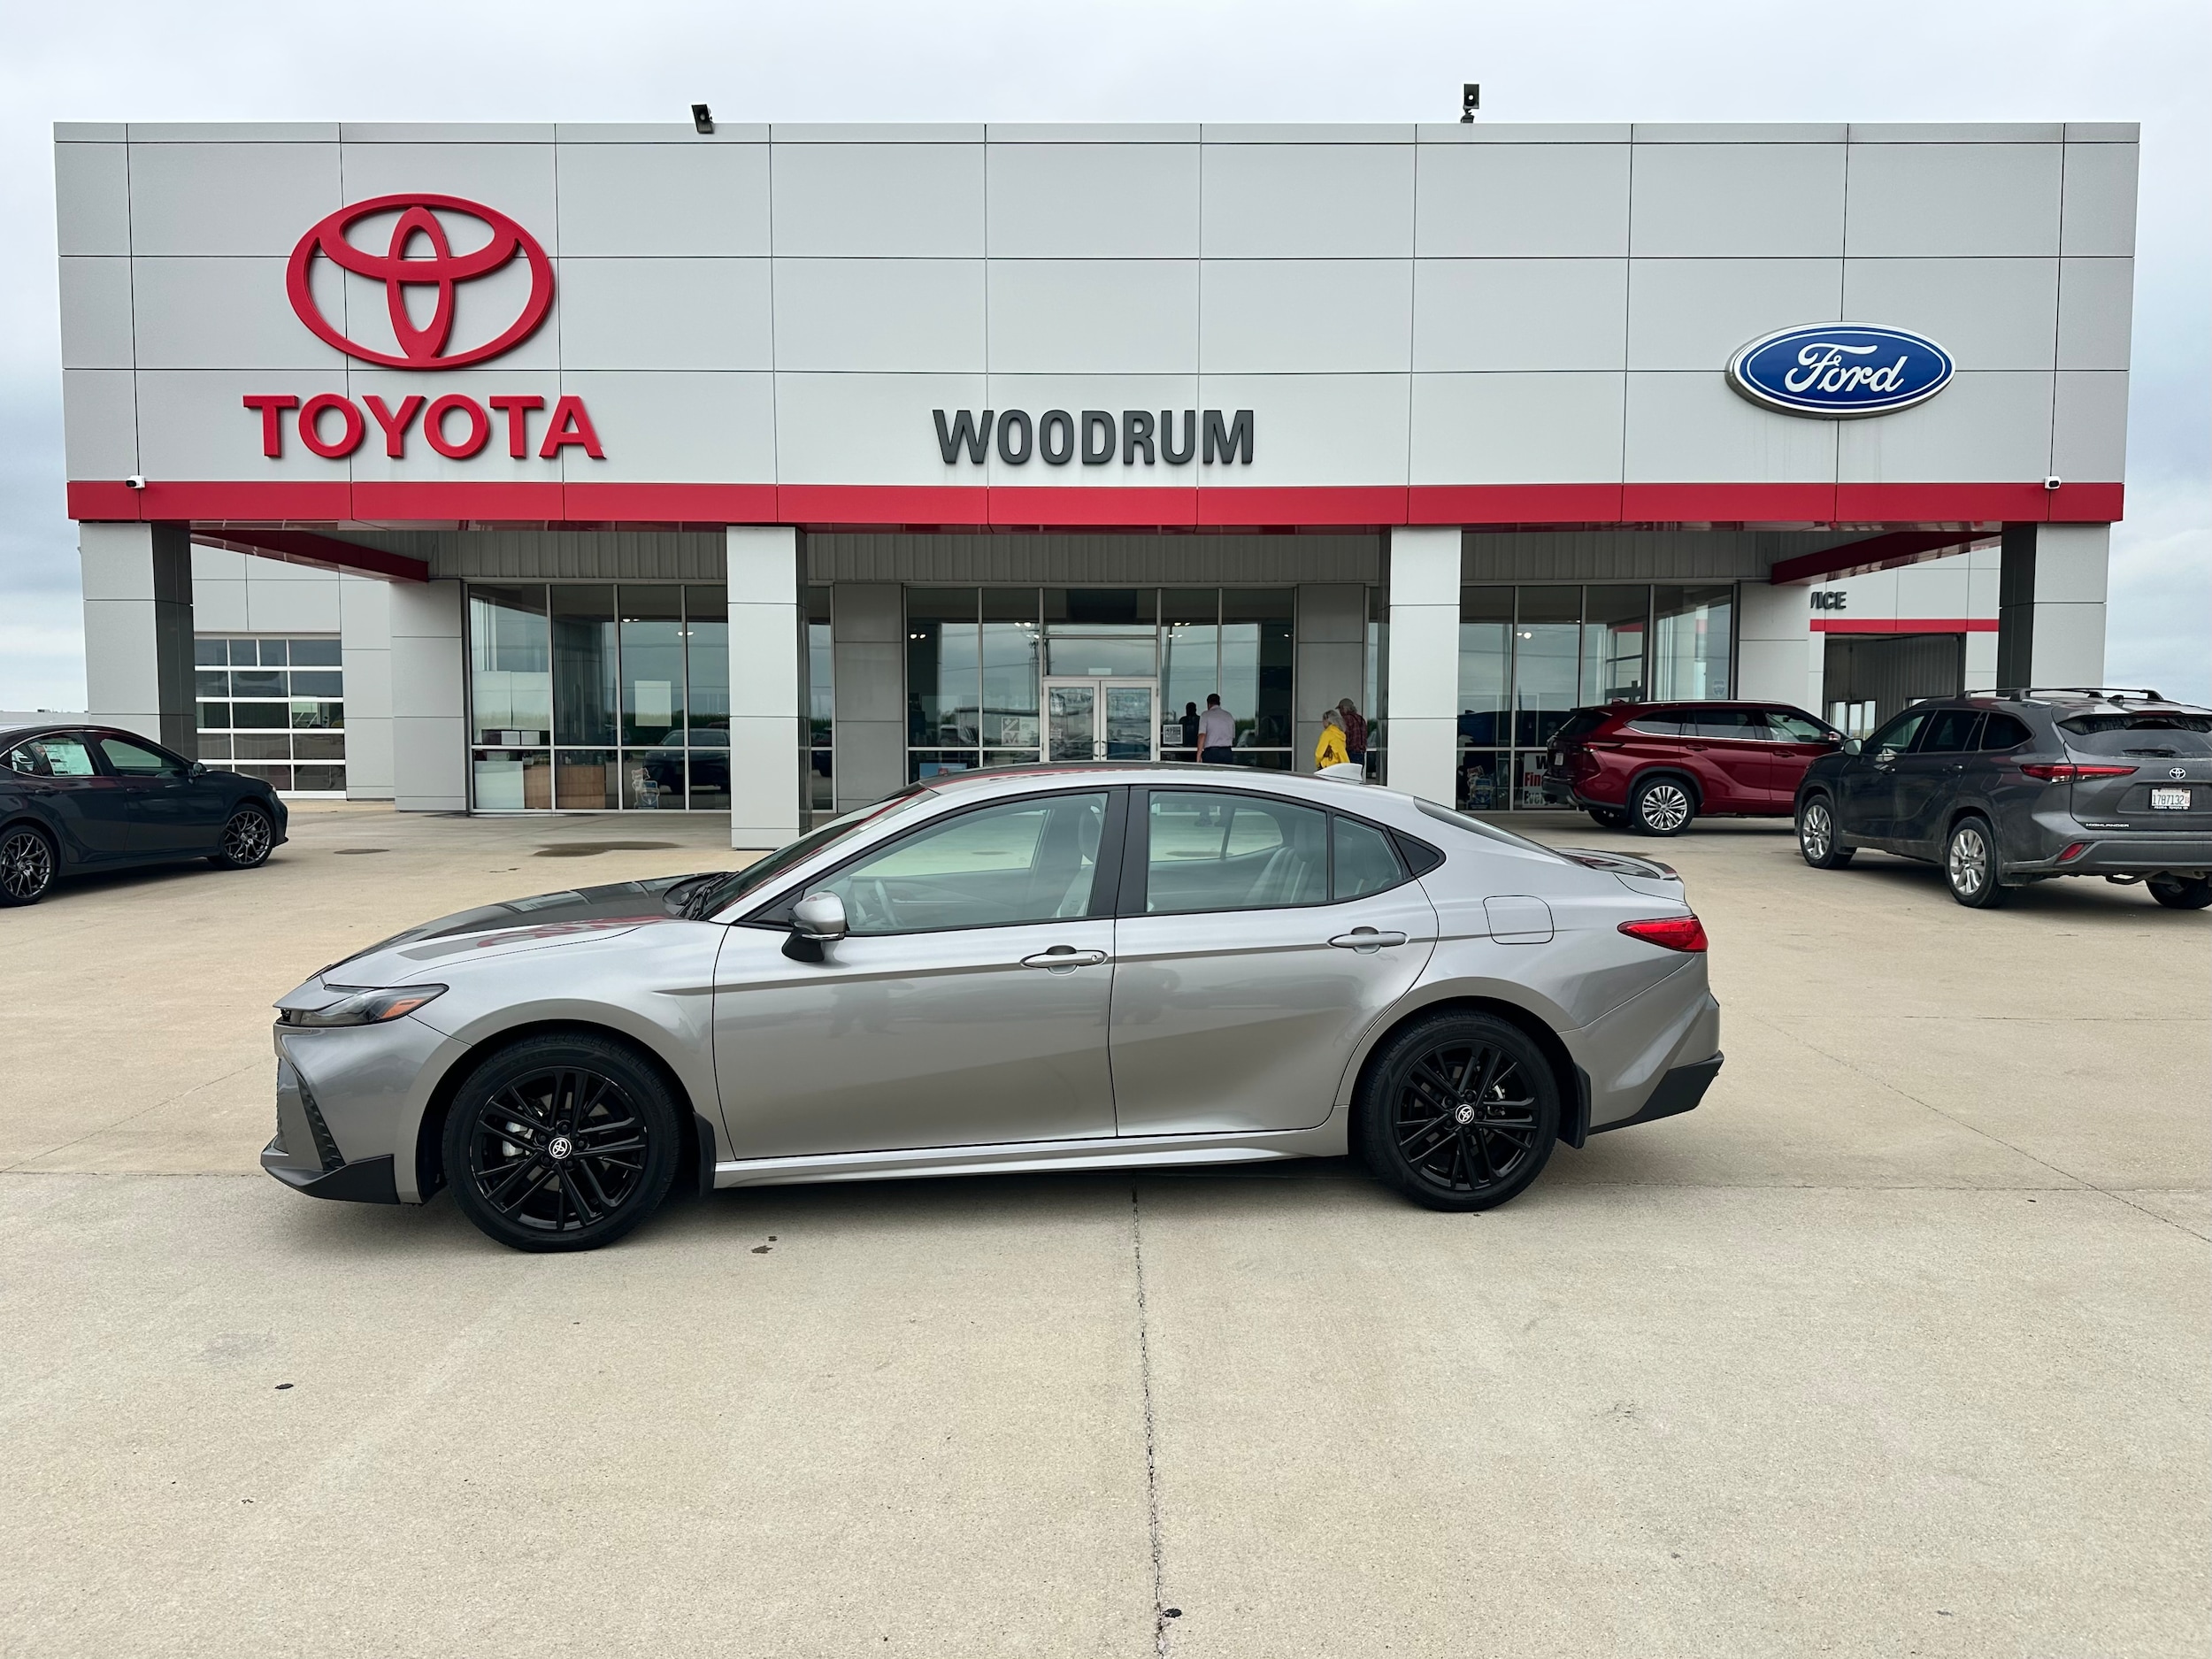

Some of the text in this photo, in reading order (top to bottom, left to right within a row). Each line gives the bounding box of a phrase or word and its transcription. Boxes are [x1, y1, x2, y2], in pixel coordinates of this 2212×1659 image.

[1785, 342, 1908, 393] Ford
[242, 393, 607, 459] TOYOTA
[933, 409, 1254, 465] WOODRUM
[1525, 772, 1541, 787] Fin
[1536, 756, 1547, 770] W
